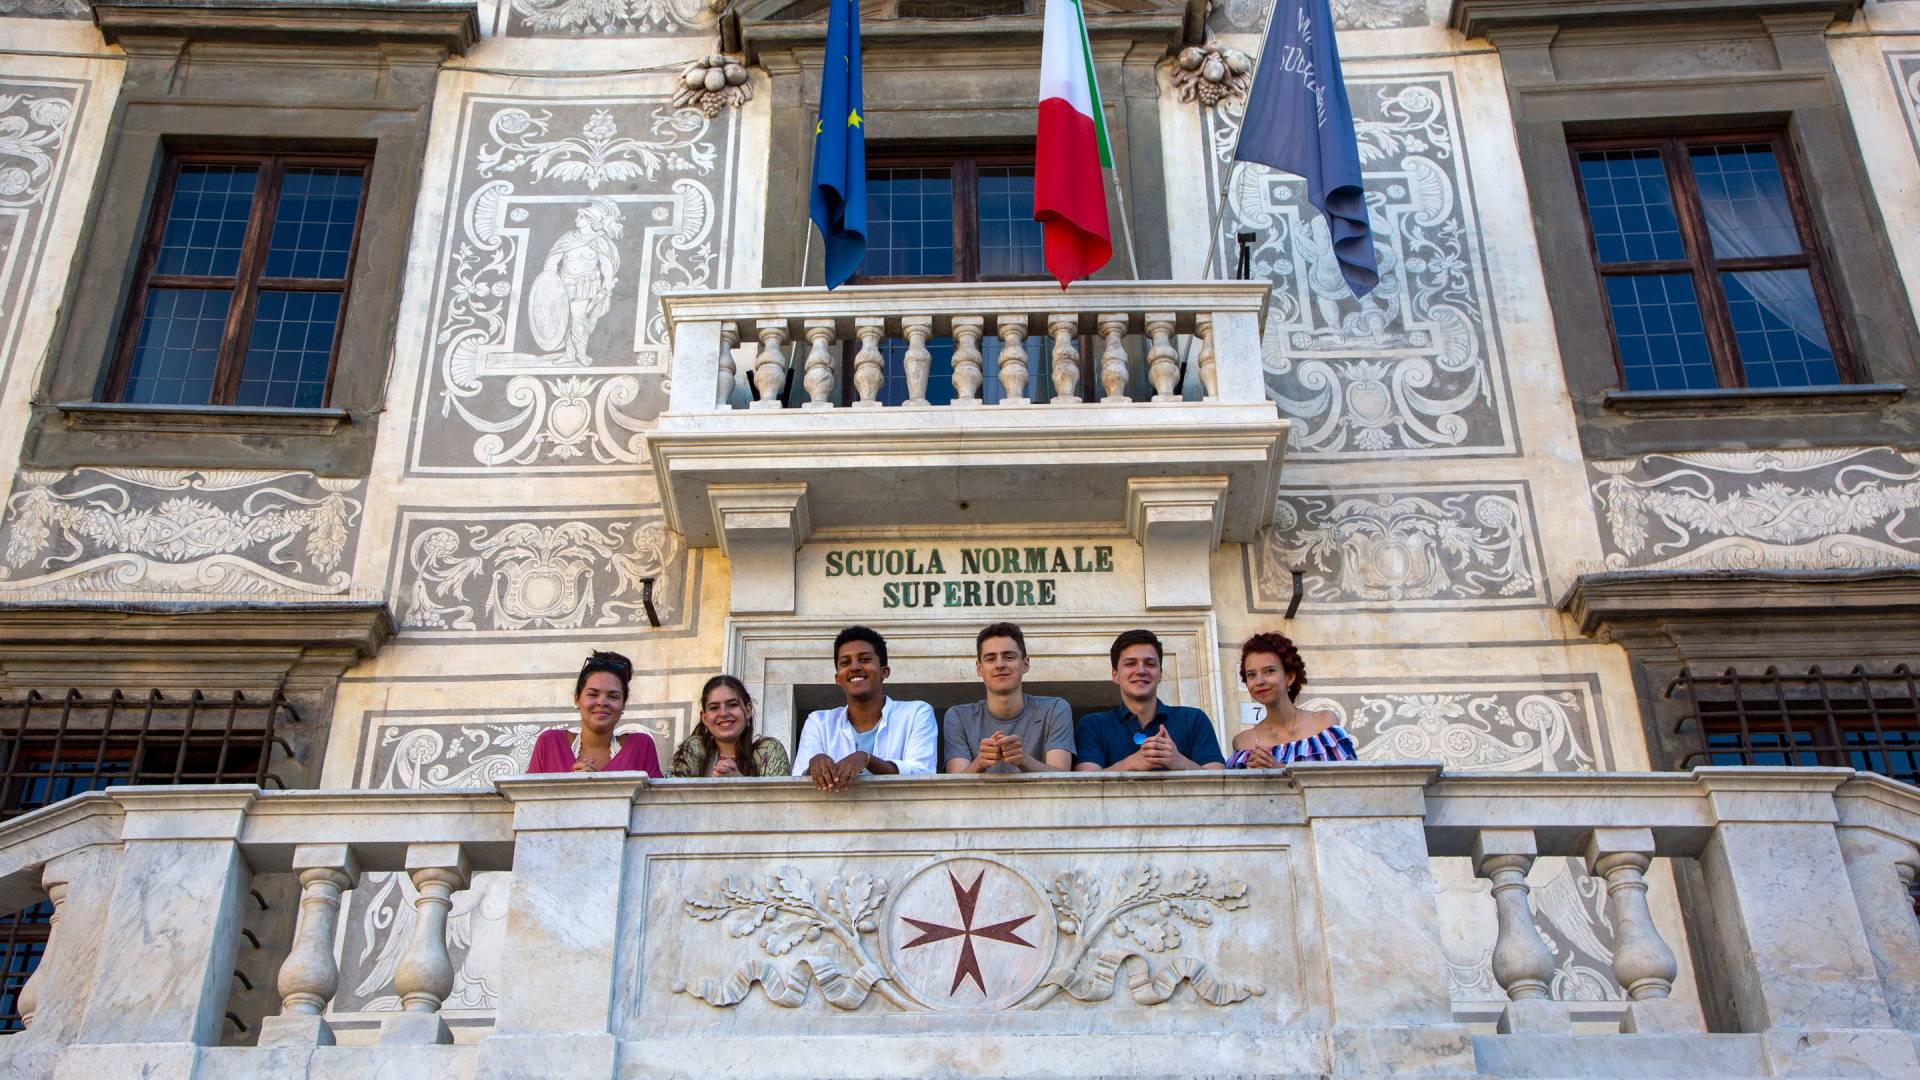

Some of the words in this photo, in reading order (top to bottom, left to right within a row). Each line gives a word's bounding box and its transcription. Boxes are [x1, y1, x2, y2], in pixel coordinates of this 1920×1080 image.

[825, 548, 946, 577] SCUOLA
[960, 545, 1114, 575] NORMALE
[883, 579, 1056, 609] SUPERIORE
[1252, 706, 1262, 721] 7
